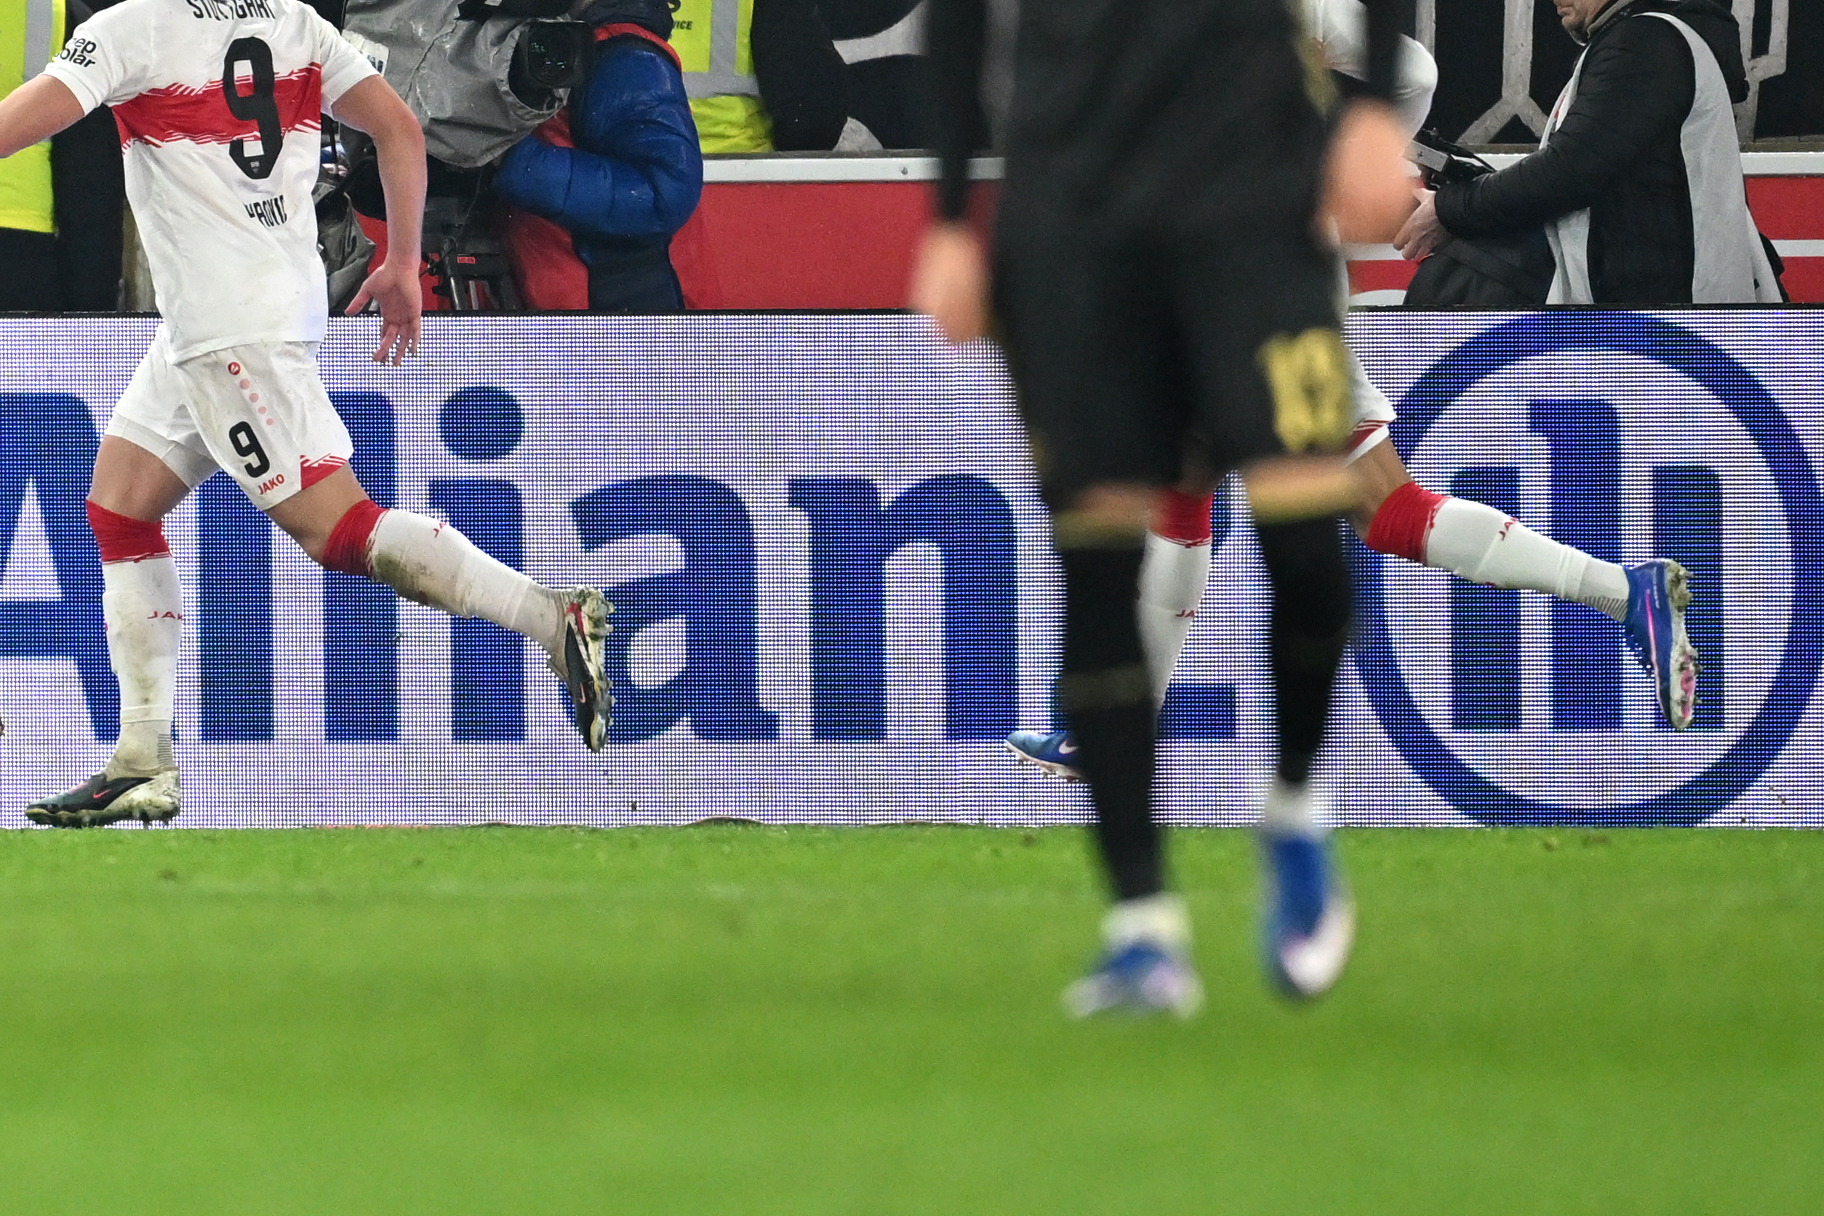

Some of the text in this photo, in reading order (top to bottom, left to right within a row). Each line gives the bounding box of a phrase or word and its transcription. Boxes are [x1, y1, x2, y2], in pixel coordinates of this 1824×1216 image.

[222, 36, 283, 180] 9
[228, 421, 271, 478] 9
[257, 474, 285, 495] JAKO
